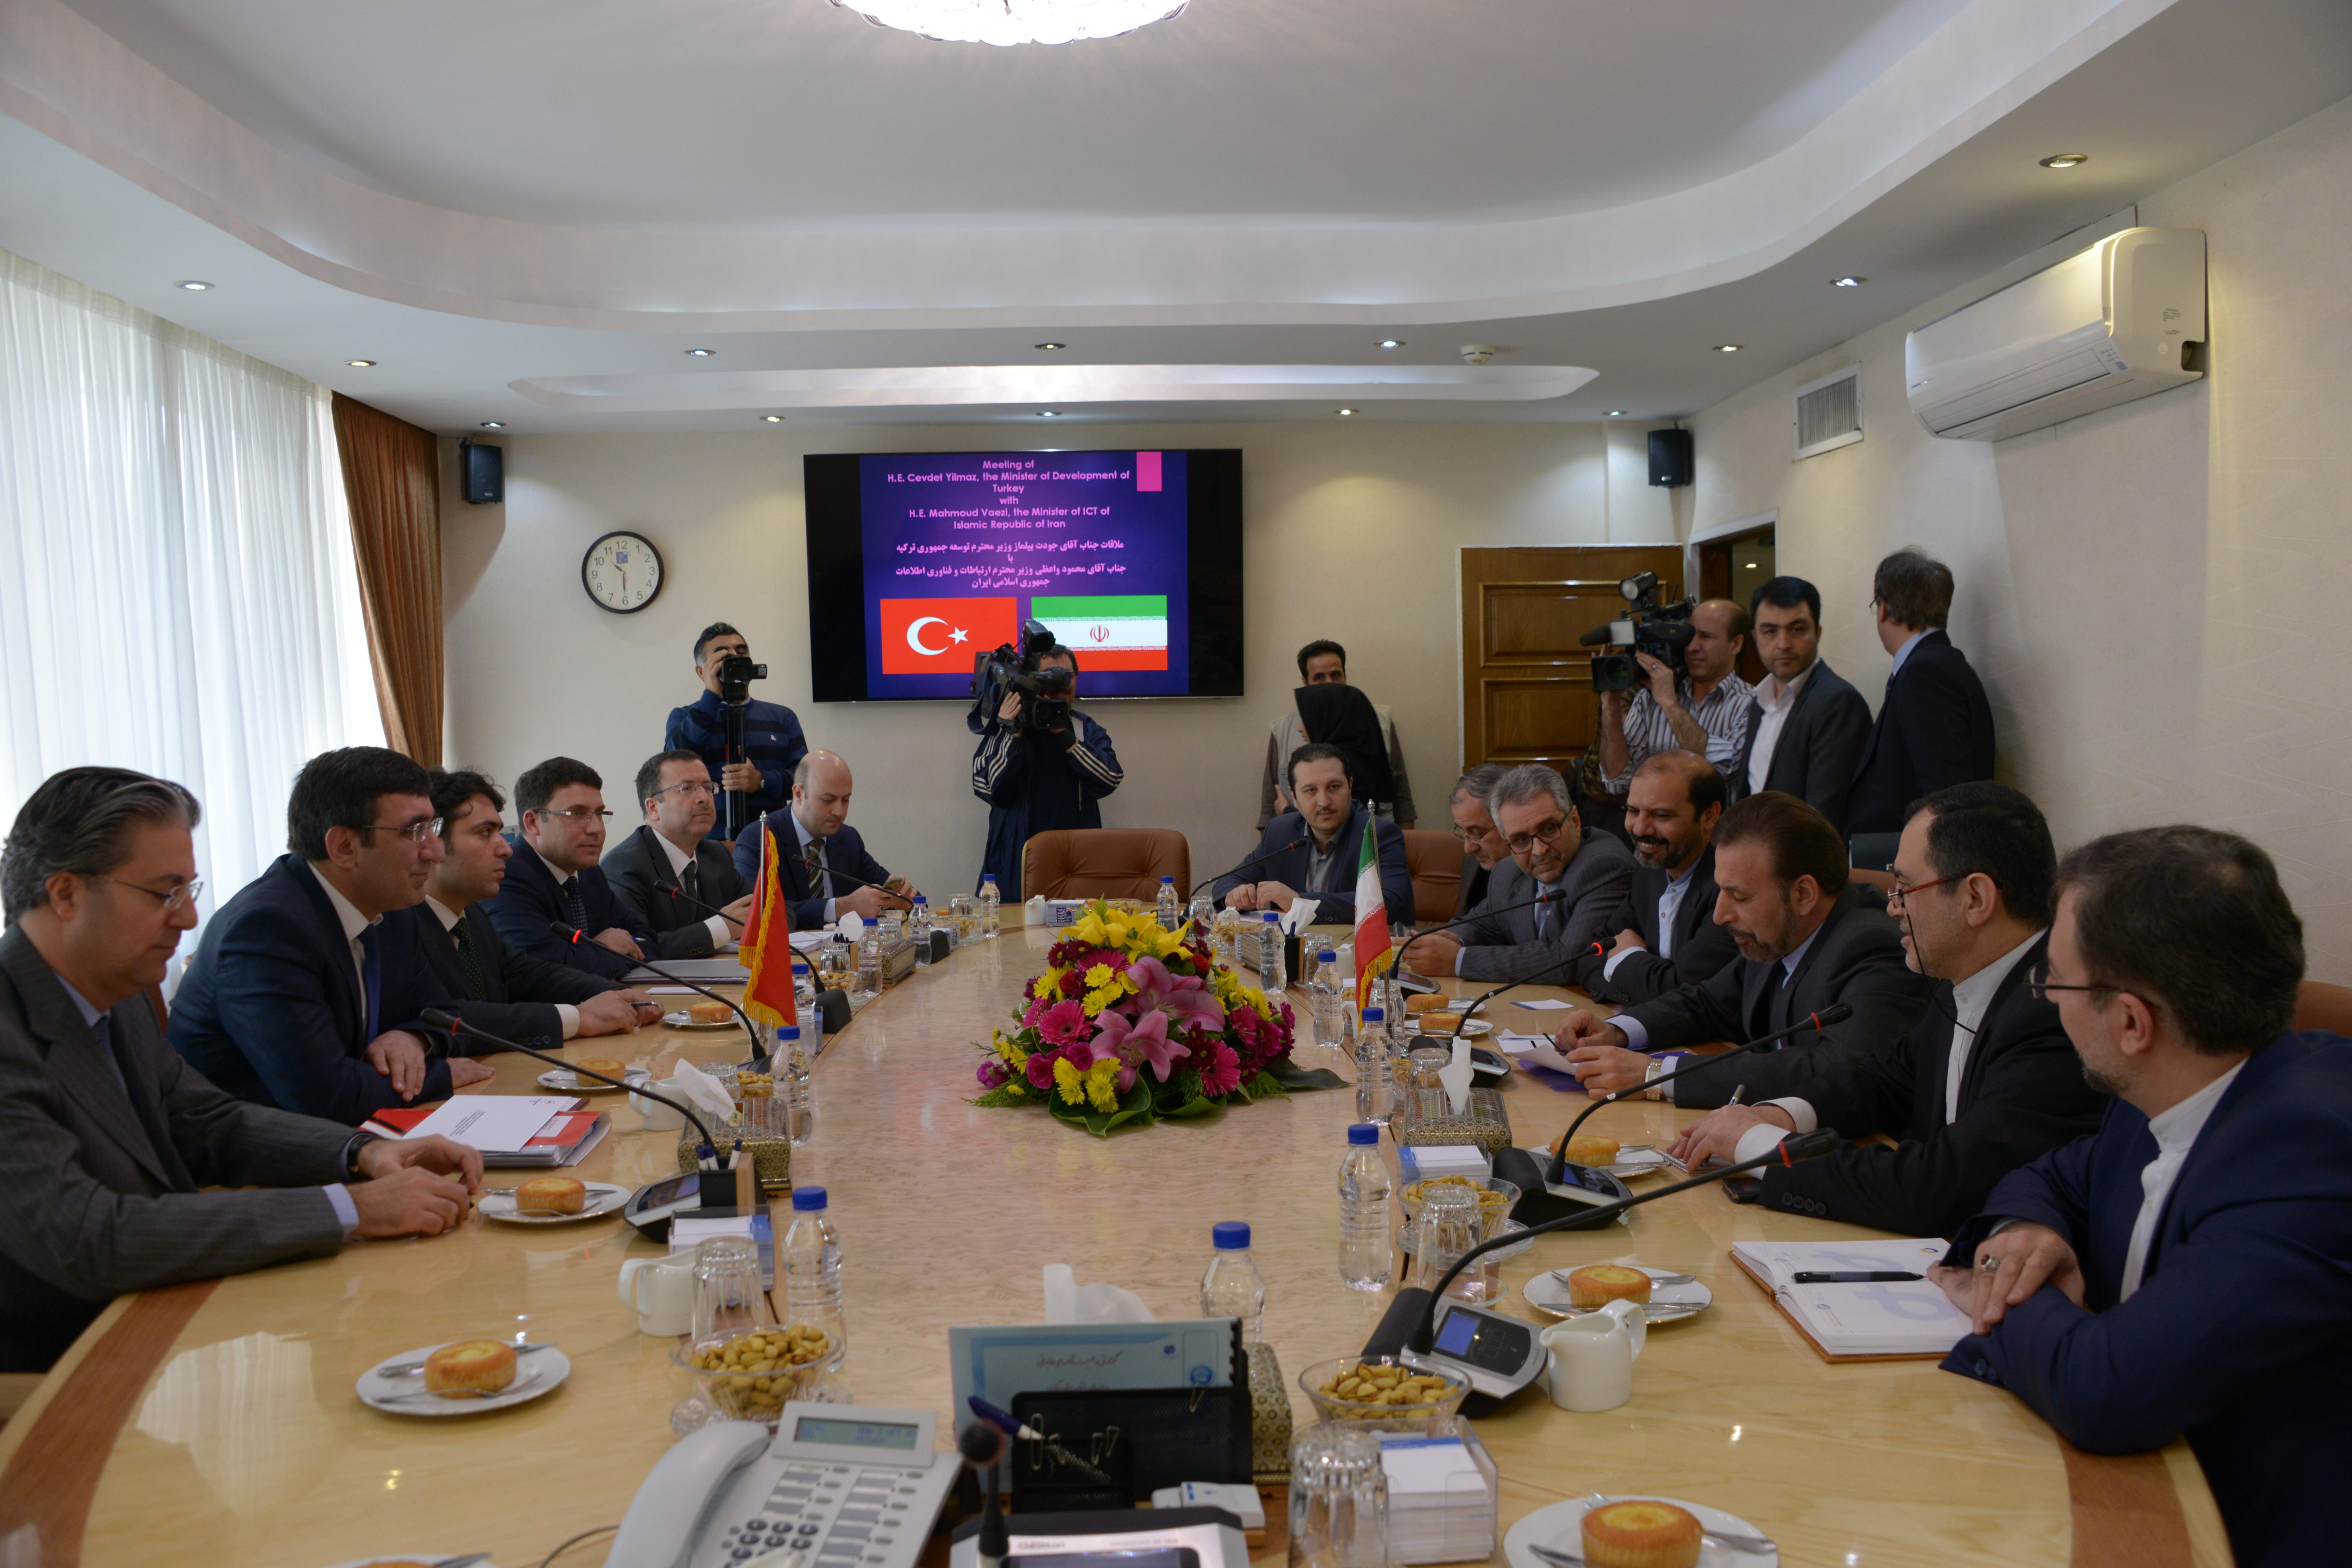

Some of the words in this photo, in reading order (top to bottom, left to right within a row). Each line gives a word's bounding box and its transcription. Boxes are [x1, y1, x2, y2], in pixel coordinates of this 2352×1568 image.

[983, 460, 1022, 470] Meeting
[1024, 460, 1035, 468] of
[888, 473, 905, 482] H.E.
[907, 473, 943, 482] Cevdet
[945, 473, 980, 482] Yilmaz,
[982, 472, 998, 481] the
[1001, 471, 1038, 481] Minister
[1040, 471, 1050, 480] of
[1052, 470, 1118, 481] Development
[1120, 470, 1130, 479] of
[992, 484, 1025, 494] Turkey
[999, 496, 1019, 504] with
[909, 509, 926, 518] H.E.
[929, 508, 978, 518] Mahmoud
[981, 507, 1010, 517] Vaezi,
[1013, 507, 1029, 516] the
[1032, 507, 1069, 516] Minister
[1071, 506, 1081, 516] of
[1083, 507, 1098, 515] ICT
[1100, 506, 1110, 515] of
[954, 520, 988, 529] Islamic
[991, 519, 1032, 530] Republic
[1035, 519, 1045, 528] of
[1047, 519, 1066, 528] Iran
[616, 540, 628, 549] 12
[636, 545, 640, 553] 1
[896, 543, 916, 554] ترکیه
[917, 544, 948, 553] جمهوری
[949, 542, 970, 553] توسعه
[971, 543, 994, 553] محترم
[995, 543, 1012, 553] وزیر
[1035, 542, 1058, 552] جودت
[1060, 539, 1078, 551] آقای
[1079, 540, 1099, 551] جناب
[1100, 539, 1124, 549] ملاقات
[604, 546, 612, 555] 11
[594, 557, 604, 566] 10
[644, 554, 650, 562] 2
[1007, 553, 1014, 564] با
[649, 566, 655, 575] 3
[895, 566, 925, 575] اطلاعات
[927, 565, 952, 577] فناوری
[954, 569, 958, 577] و
[960, 565, 991, 576] ارتباطات
[992, 566, 1015, 576] محترم
[1017, 566, 1033, 576] وزیر
[1035, 564, 1061, 576] واعظی
[1061, 566, 1086, 575] محمود
[1087, 563, 1106, 575] آقای
[1107, 564, 1126, 575] جناب
[591, 571, 597, 579] 9
[597, 582, 602, 591] 8
[646, 579, 652, 588] 4
[971, 577, 992, 588] ایران
[992, 577, 1018, 588] اسلامی
[1019, 579, 1050, 588] جمهوری
[608, 593, 614, 602] 7
[637, 591, 643, 600] 5
[622, 597, 628, 605] 6
